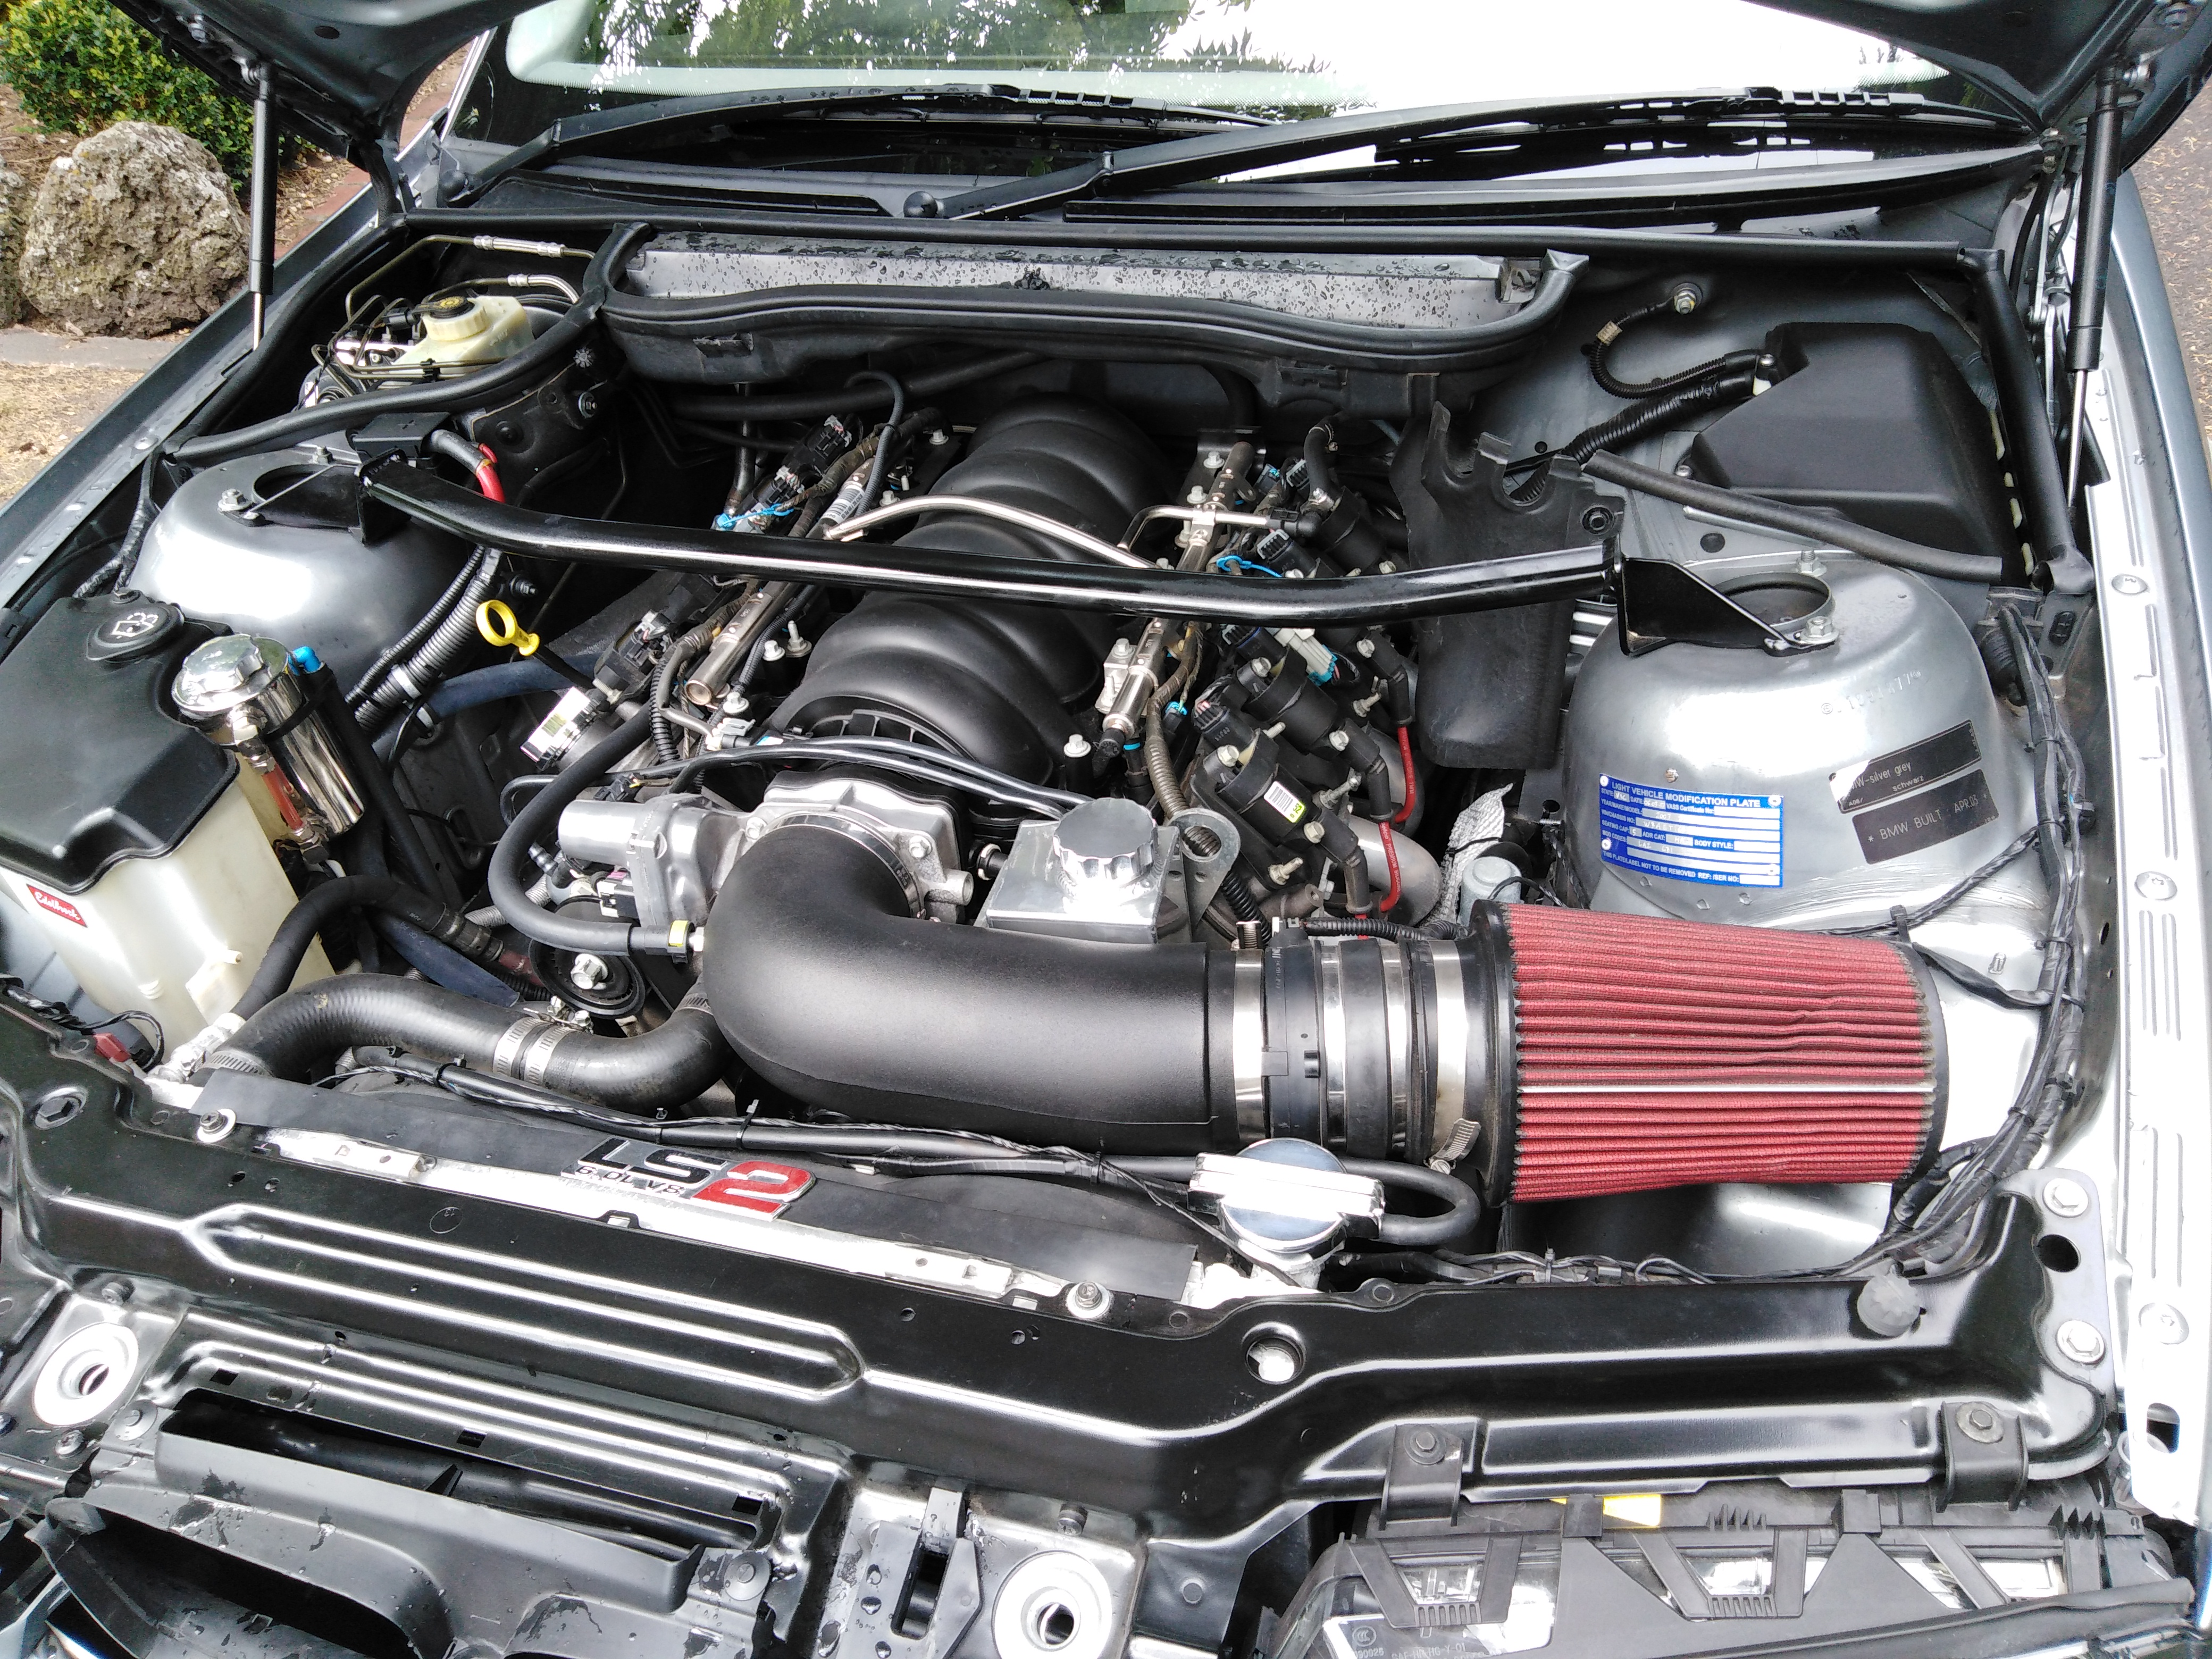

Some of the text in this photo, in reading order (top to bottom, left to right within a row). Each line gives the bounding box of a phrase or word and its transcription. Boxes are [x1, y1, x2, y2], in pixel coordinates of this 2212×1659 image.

[1894, 762, 1911, 776] grey
[1892, 775, 1924, 792] schwarz
[1612, 782, 1761, 808] LIGHT VEHICLE MODIFICATION PLATE
[1630, 796, 1644, 805] DATE:
[1293, 802, 1302, 814] 52
[1879, 794, 1978, 840] BMW BUILT APR.03
[1602, 819, 1619, 830] SEATING
[1654, 832, 1665, 841] CAT:
[1386, 843, 1397, 869] PREMIUM
[1613, 853, 1640, 867] PLATE/LABEL
[1669, 868, 1696, 877] REMOVED
[648, 1179, 685, 1194] V8
